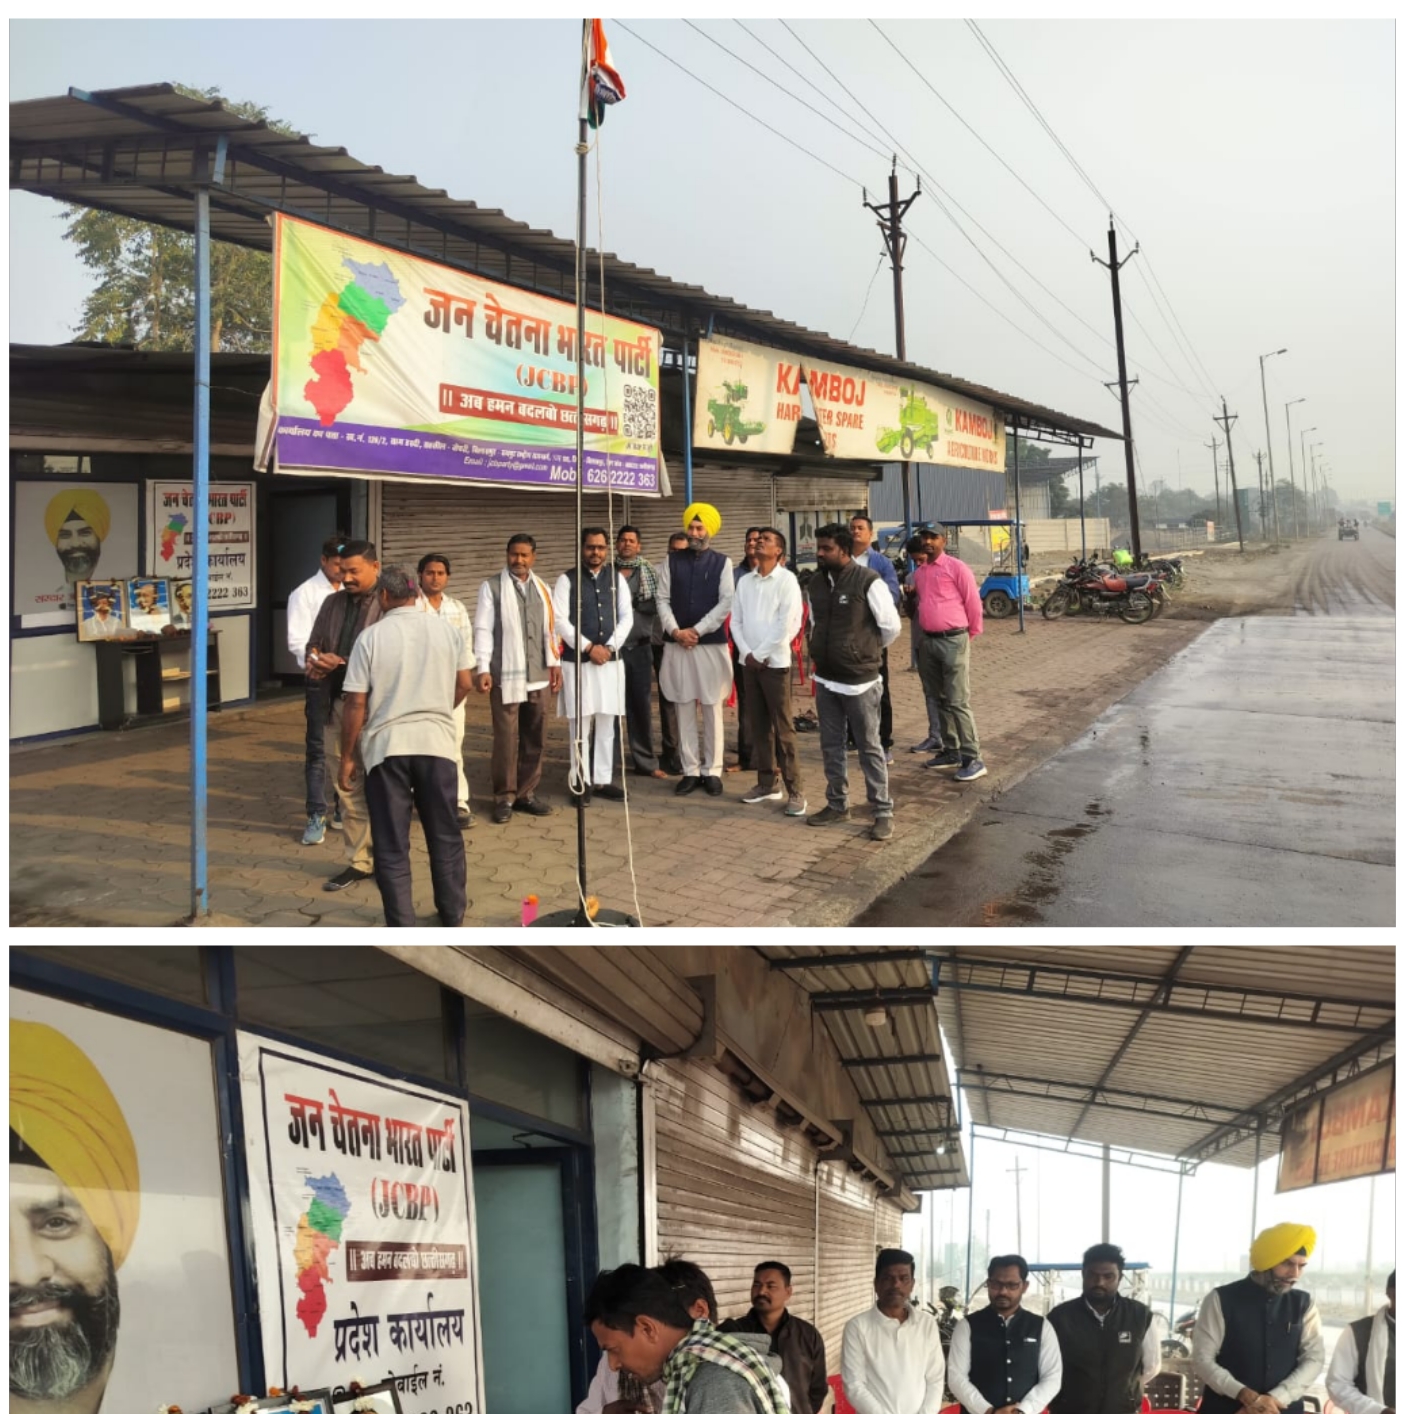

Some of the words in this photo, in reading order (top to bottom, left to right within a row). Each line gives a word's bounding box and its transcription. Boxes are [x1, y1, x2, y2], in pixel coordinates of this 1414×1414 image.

[423, 288, 476, 338] जन
[483, 292, 552, 357] चेतना
[613, 336, 652, 378] पार्टी
[460, 393, 483, 411] अब
[487, 398, 514, 414] हमन
[518, 402, 557, 421] बदलबो
[836, 411, 864, 430] SPARE
[956, 407, 993, 440] KAMBOJ
[464, 456, 483, 465] Email
[587, 469, 607, 483] 626
[609, 470, 636, 485] 2222
[638, 473, 655, 487] 363
[177, 551, 193, 569] प्रदे
[232, 586, 249, 598] 363
[284, 1093, 326, 1151] जन
[329, 1088, 381, 1161] चेतना
[385, 1118, 423, 1168] भारत
[426, 1118, 456, 1173] पार्टी
[370, 1177, 439, 1223] (JCBP)
[361, 1250, 375, 1270] अब
[377, 1251, 392, 1270] हमन
[393, 1246, 419, 1270] बदलबो
[334, 1301, 379, 1362] प्रदेश
[387, 1292, 464, 1354] कार्यालय
[433, 1364, 445, 1387] नं.
